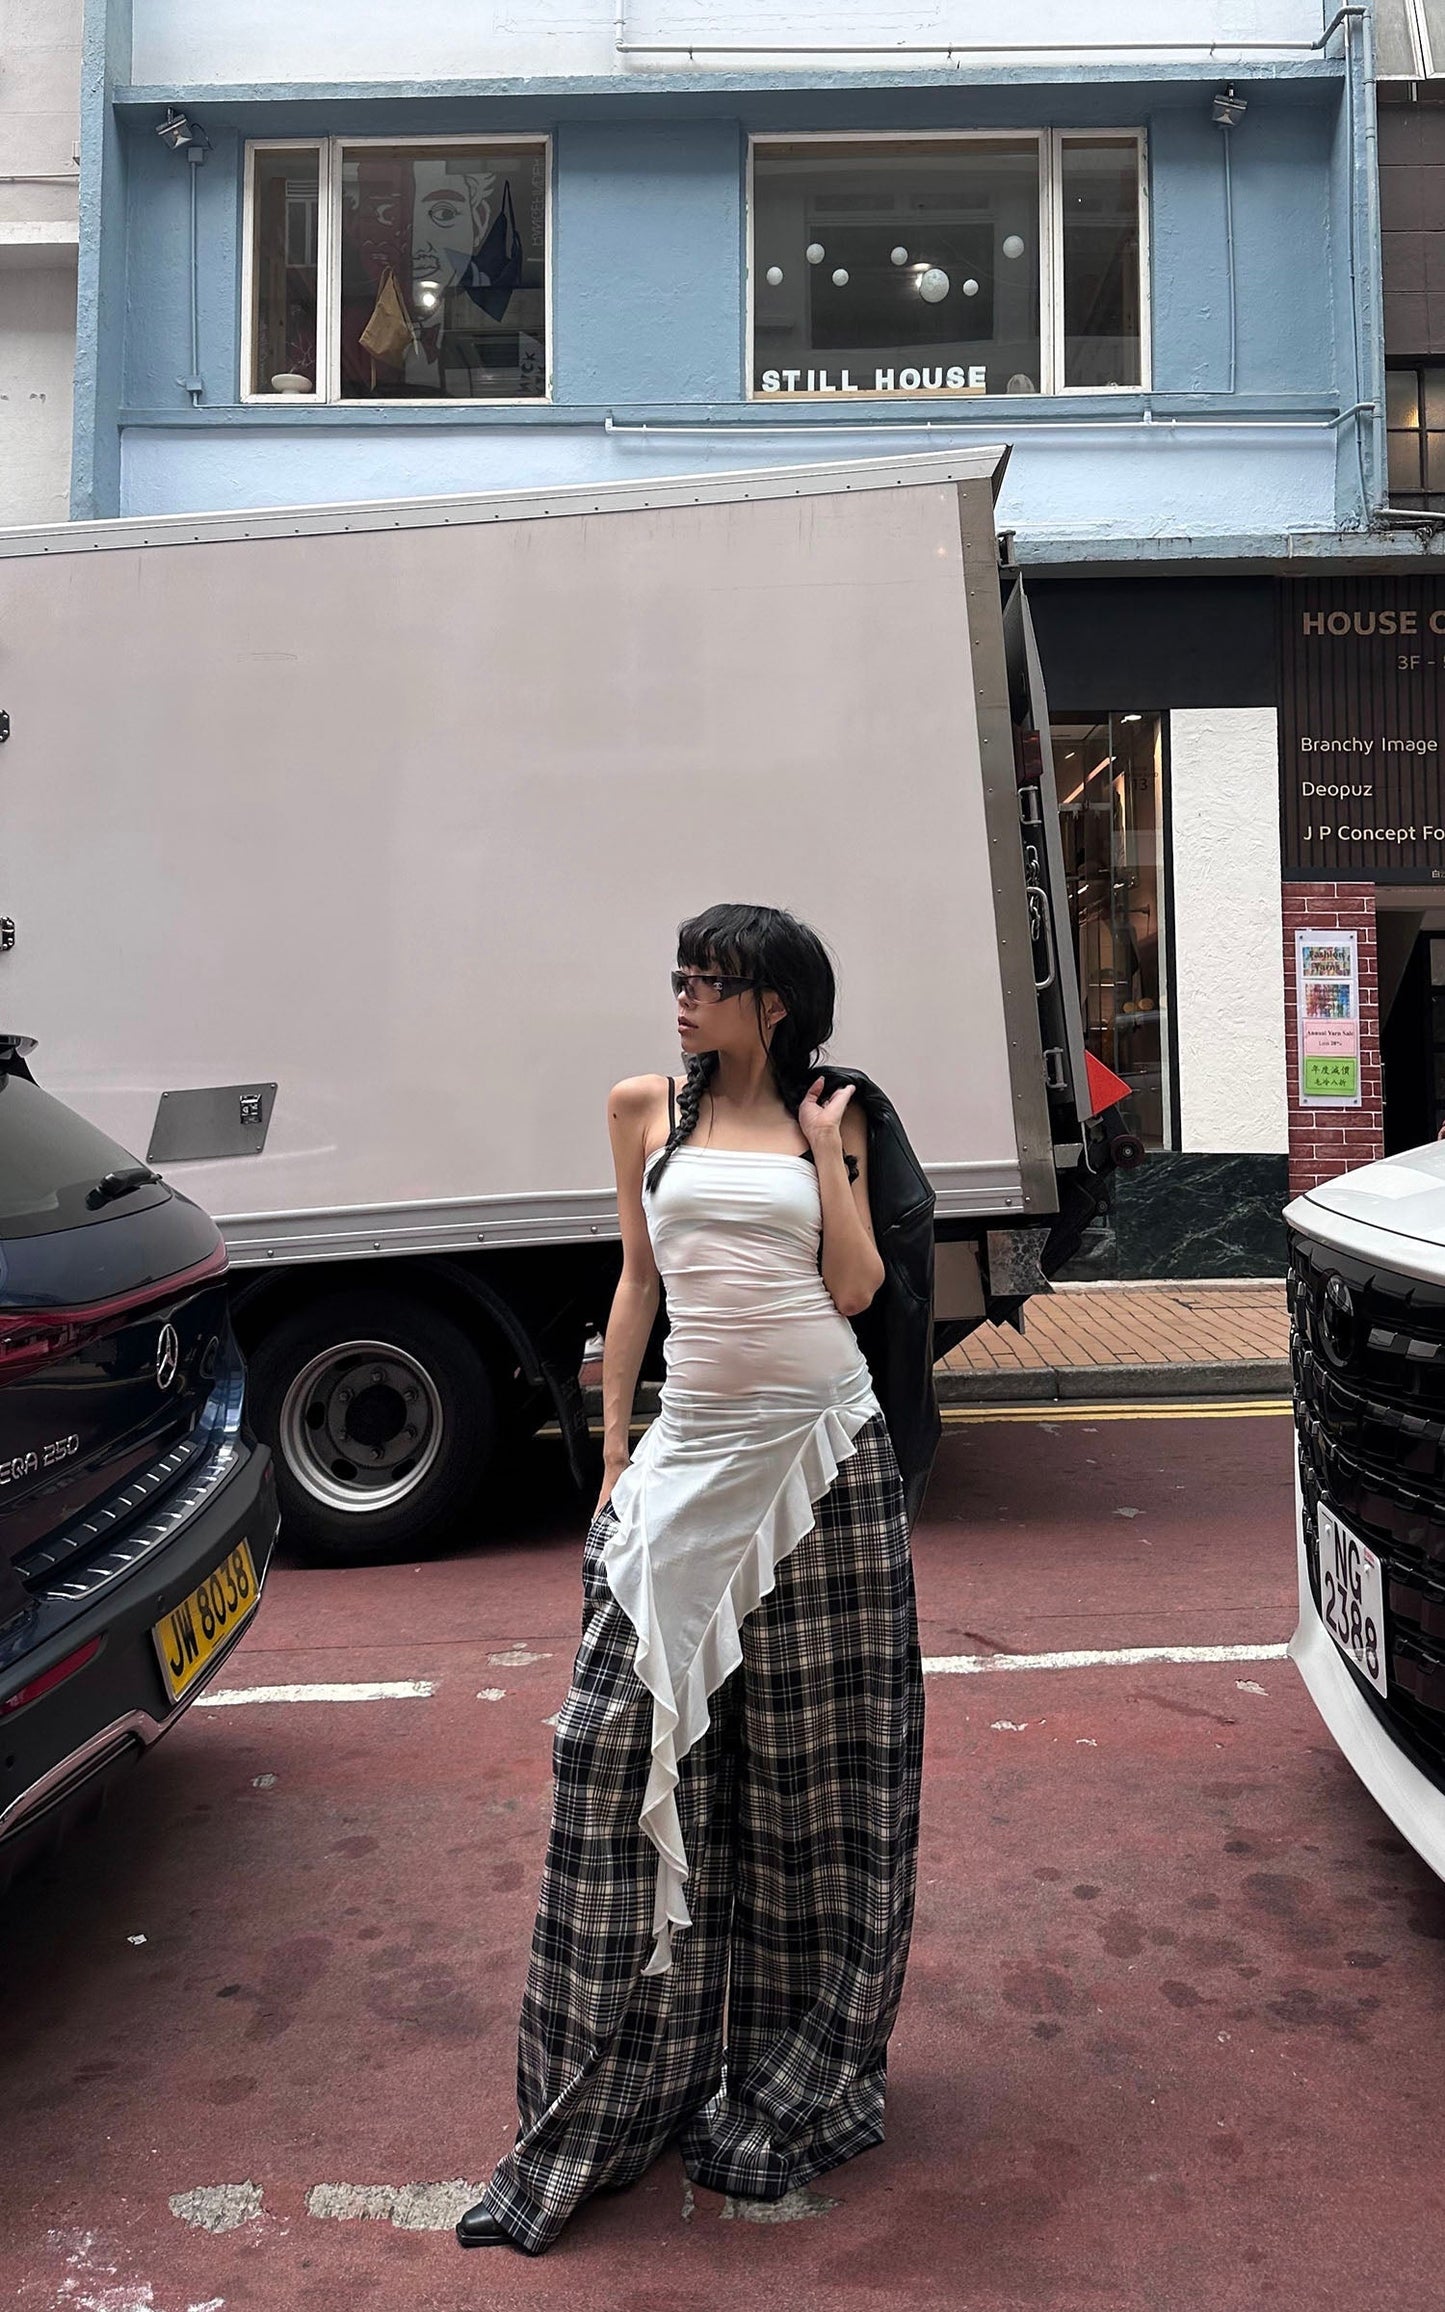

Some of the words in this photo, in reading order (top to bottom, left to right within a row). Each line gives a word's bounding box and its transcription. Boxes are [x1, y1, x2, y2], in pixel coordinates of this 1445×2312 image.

[762, 369, 858, 392] STILL
[875, 366, 987, 391] HOUSE
[1303, 611, 1417, 635] HOUSE
[1398, 655, 1420, 670] 3F
[1301, 737, 1374, 755] Branchy
[1382, 737, 1438, 755] Image
[1302, 781, 1373, 800] Deopuz
[1303, 826, 1312, 840] J
[1319, 826, 1331, 840] P
[1338, 825, 1416, 844] Concept
[1423, 826, 1445, 840] Fo
[0, 1452, 38, 1485] EQA
[43, 1434, 79, 1467] 250
[1333, 1521, 1362, 1605] NG
[170, 1601, 199, 1677] JW
[197, 1550, 249, 1640] 8038
[1325, 1571, 1379, 1680] 2388
